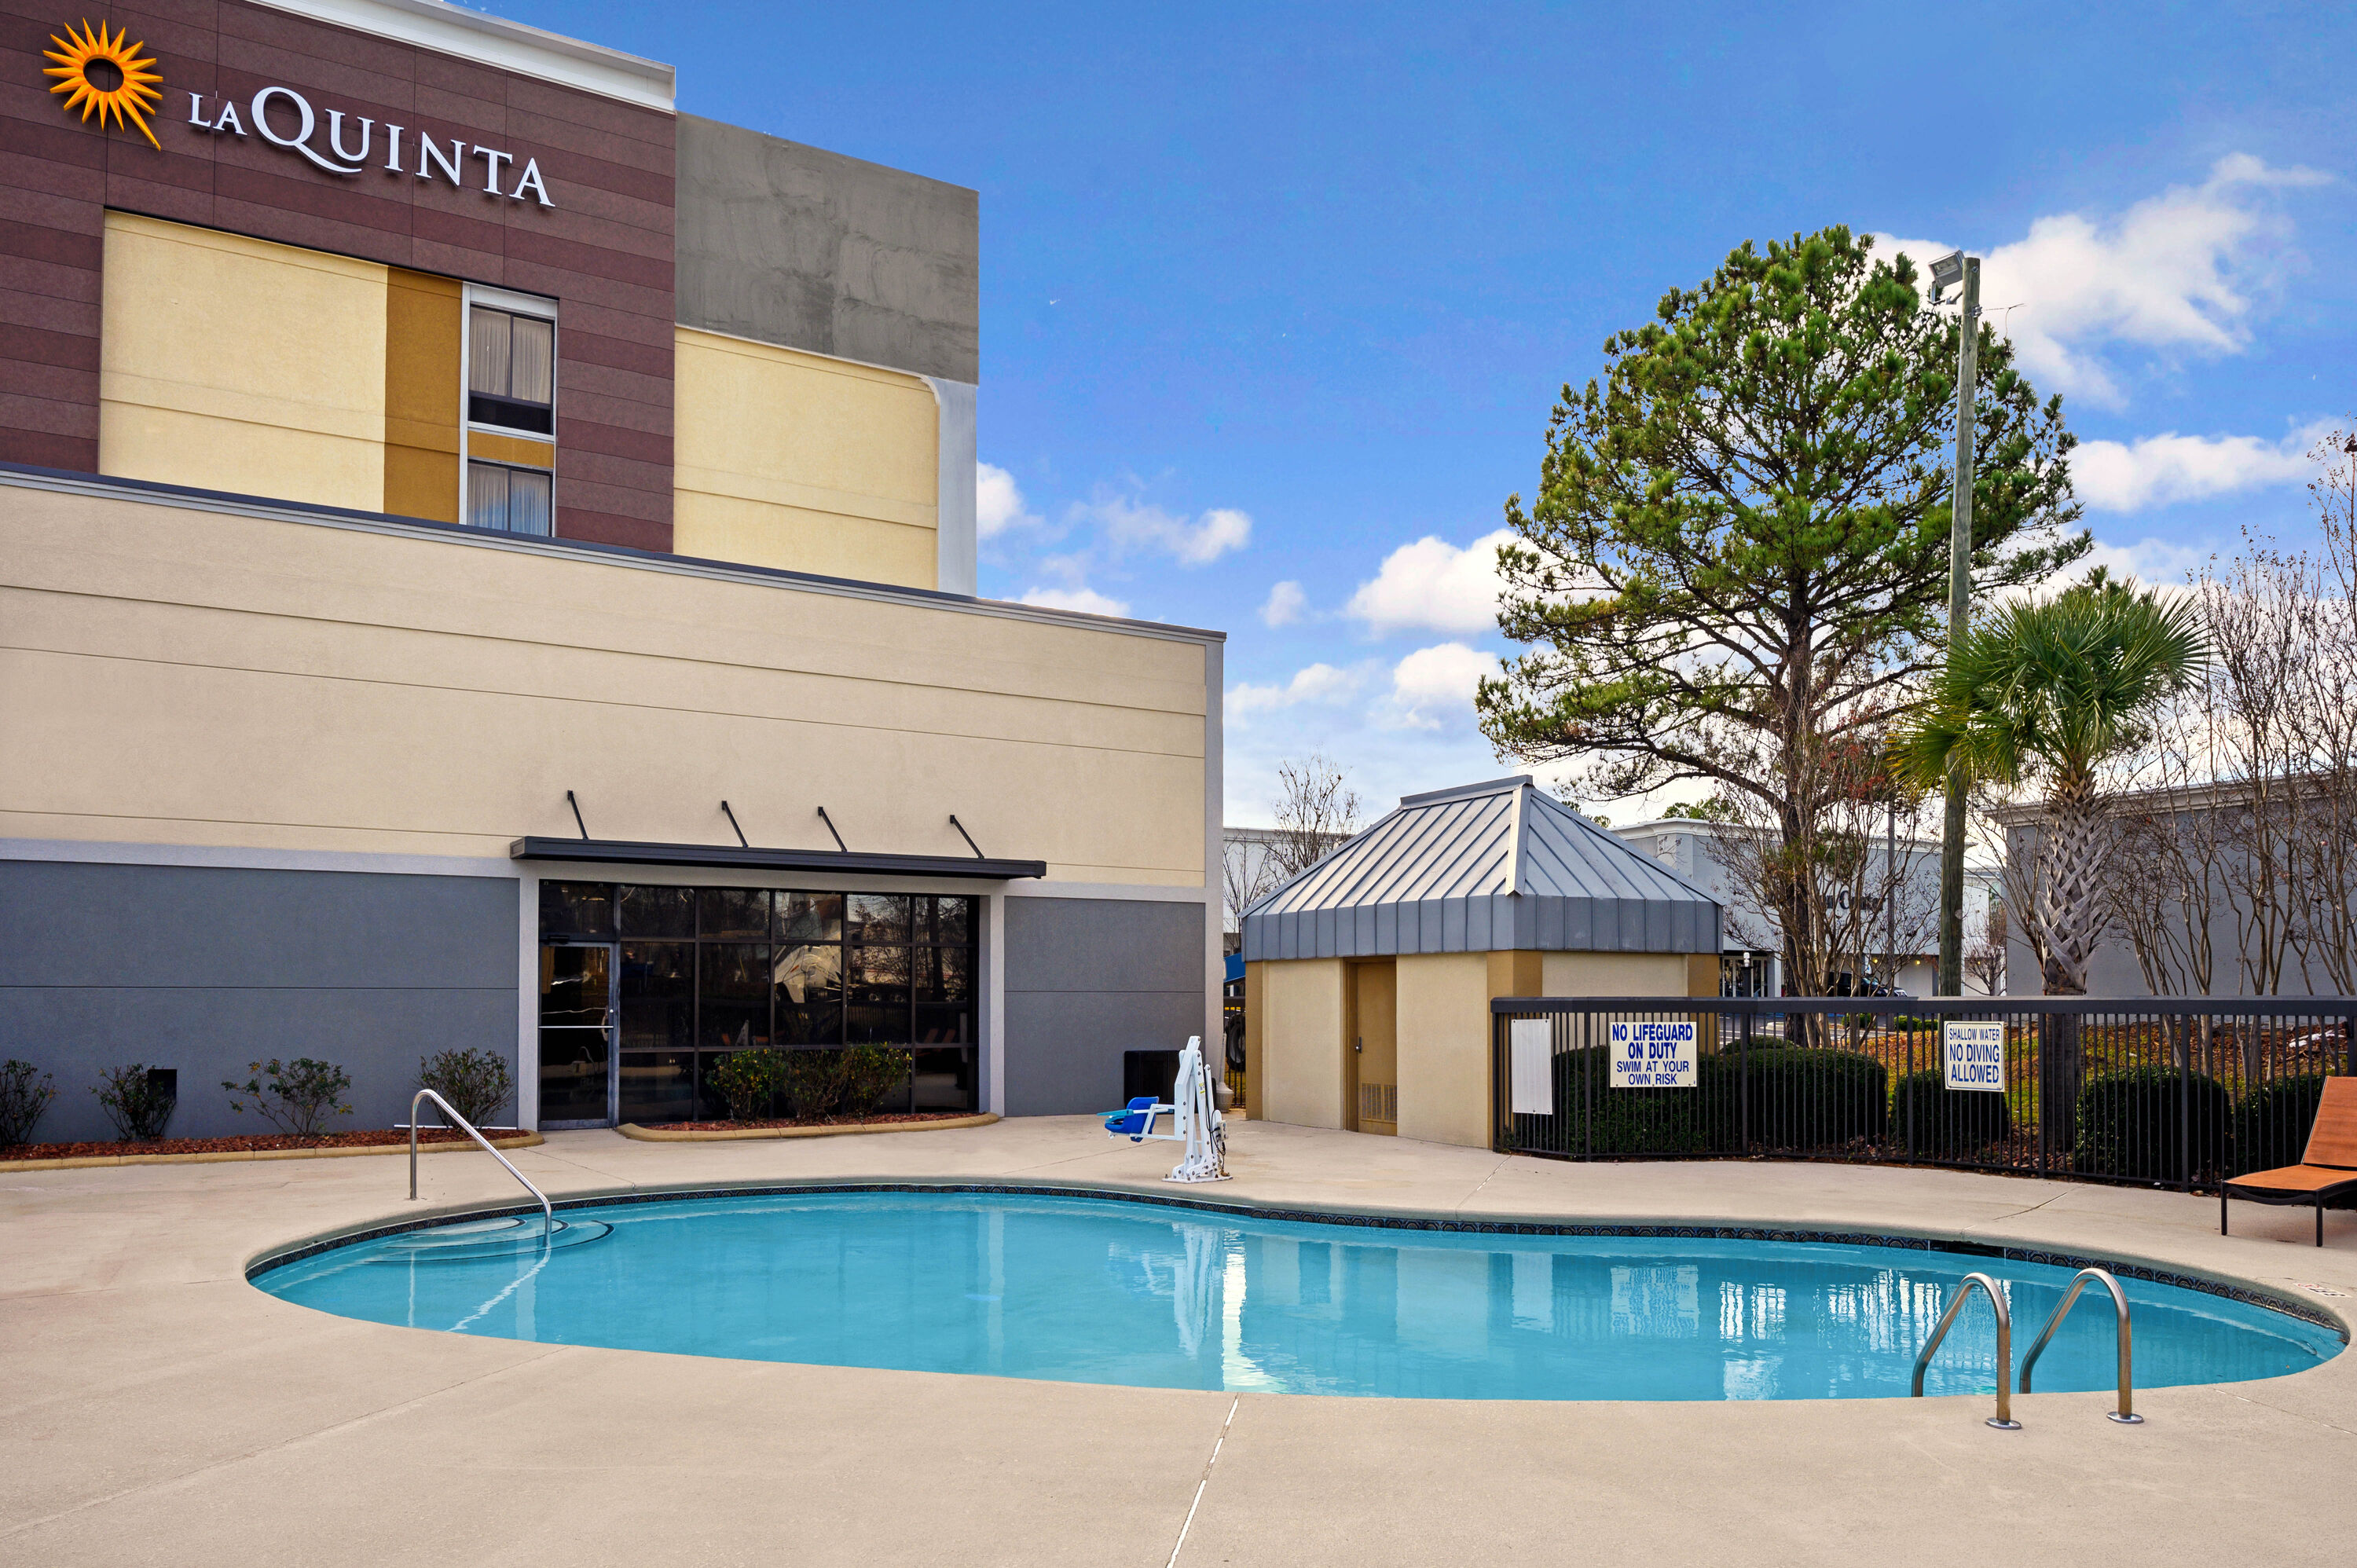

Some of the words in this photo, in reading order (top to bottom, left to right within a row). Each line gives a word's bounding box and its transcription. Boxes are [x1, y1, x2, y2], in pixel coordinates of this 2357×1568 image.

[1612, 1024, 1628, 1042] NO
[1633, 1024, 1693, 1042] LIFEGUARD
[1948, 1028, 1978, 1041] SHALLOW
[1979, 1028, 2000, 1041] WATER
[1628, 1042, 1644, 1060] ON
[1648, 1042, 1677, 1060] DUTY
[1949, 1043, 1963, 1062] NO
[1966, 1043, 2000, 1063] DIVING
[1616, 1061, 1641, 1073] SWIM
[1645, 1061, 1659, 1073] AT
[1662, 1061, 1689, 1073] YOUR
[1951, 1063, 2000, 1084] ALLOWED
[1628, 1073, 1651, 1086] OWN
[1655, 1073, 1677, 1086] RISK
